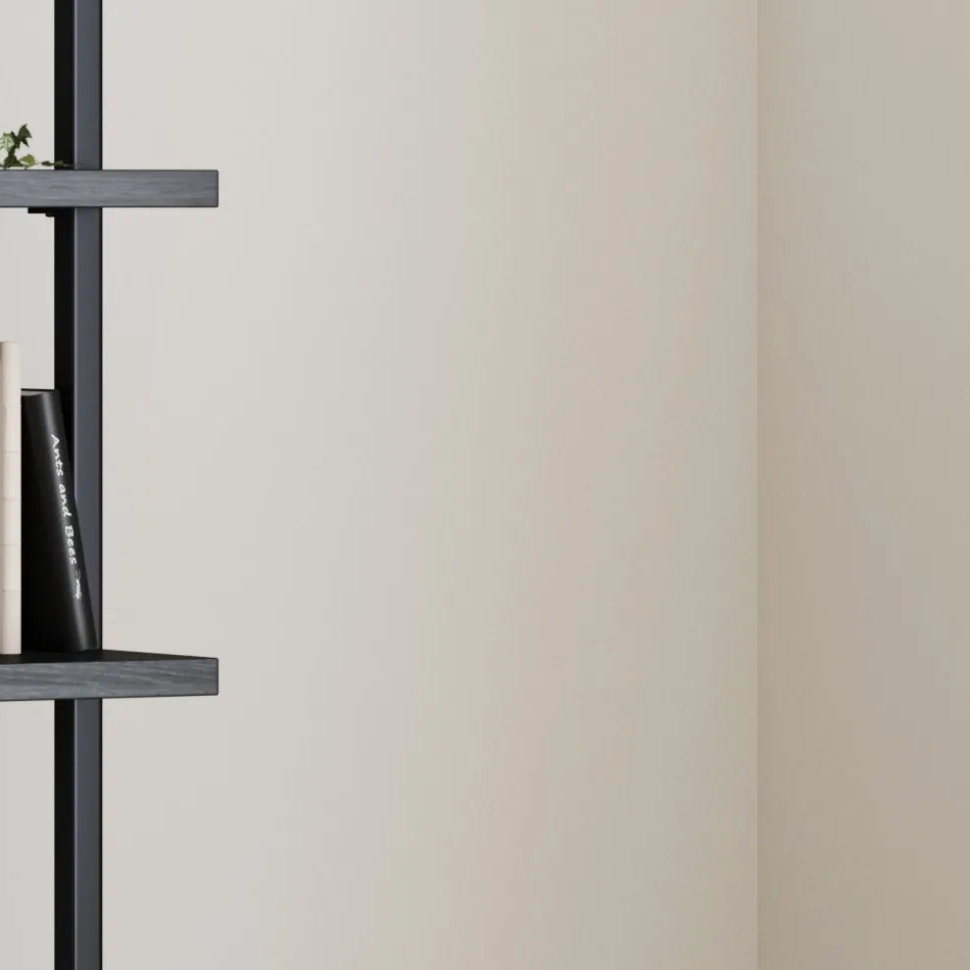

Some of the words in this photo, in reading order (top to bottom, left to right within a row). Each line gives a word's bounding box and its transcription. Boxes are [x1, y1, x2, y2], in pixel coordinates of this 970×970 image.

[51, 433, 65, 476] Ants
[58, 483, 72, 517] and
[64, 525, 77, 565] Bees
